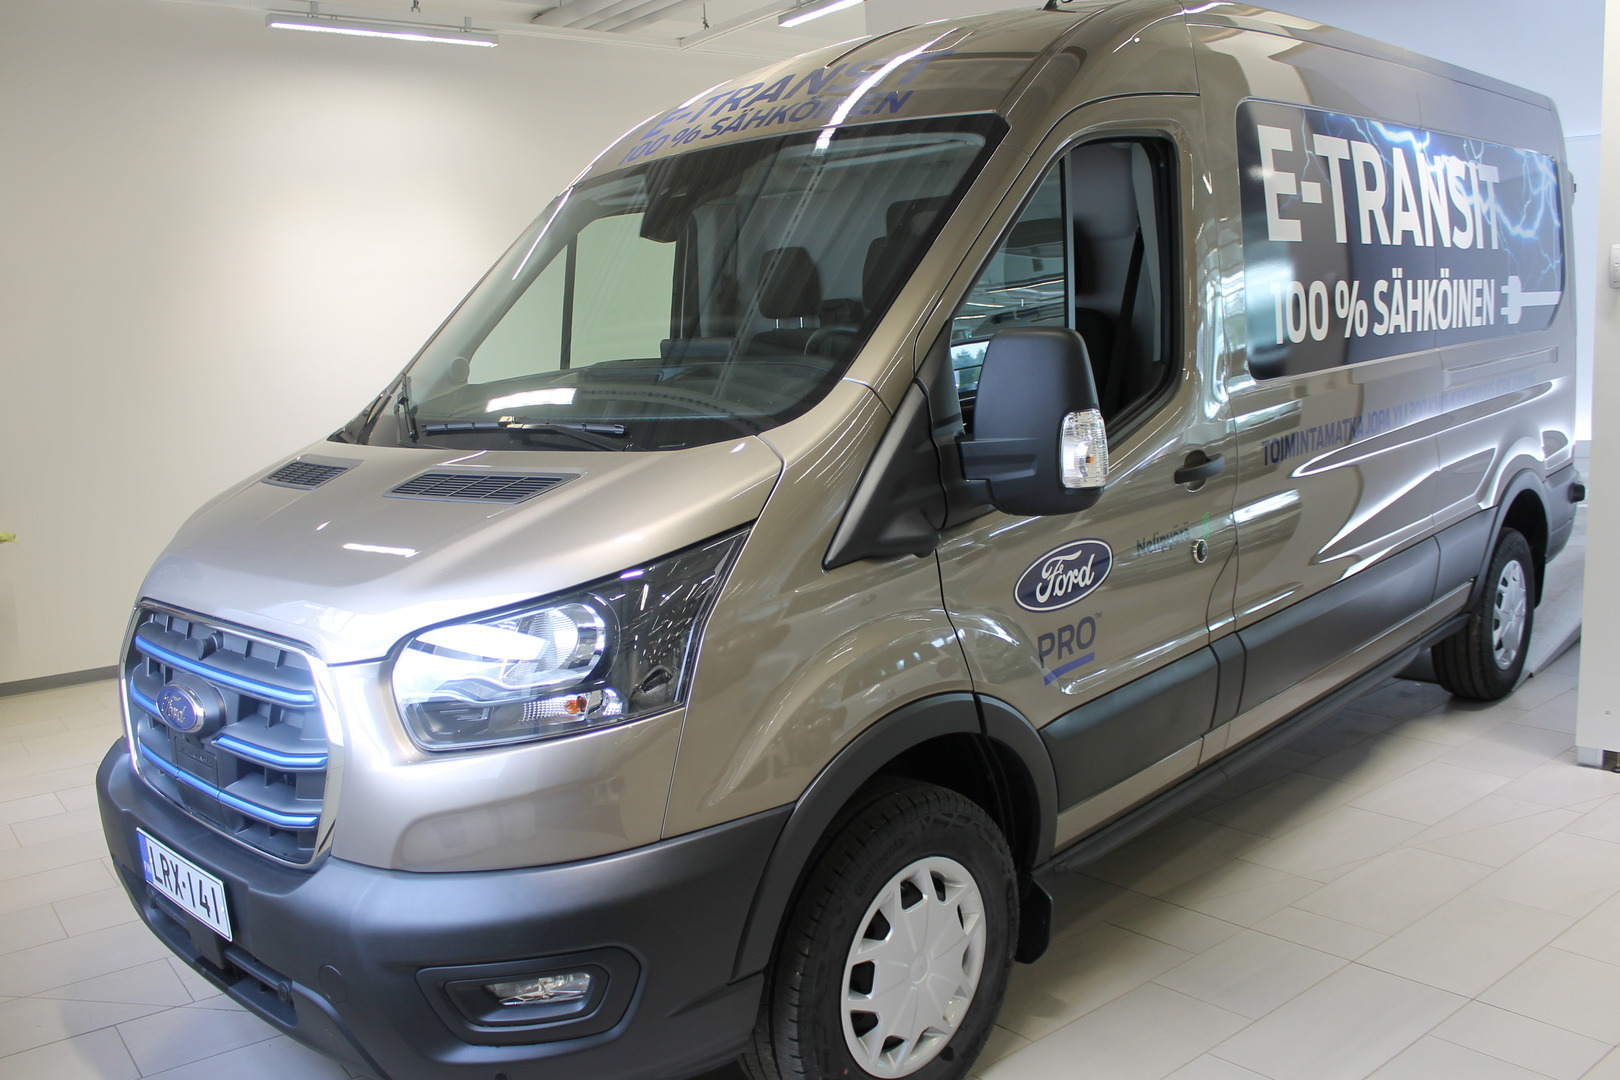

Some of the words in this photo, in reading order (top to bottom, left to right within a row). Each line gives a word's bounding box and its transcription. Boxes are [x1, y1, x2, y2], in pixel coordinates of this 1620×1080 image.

[640, 50, 953, 141] E-TRANST
[617, 134, 670, 166] 100
[671, 123, 703, 148] %
[1257, 124, 1500, 250] E-TRANSIT
[1271, 280, 1329, 345] 100
[1335, 280, 1368, 338] %
[1372, 267, 1495, 335] SÄHKÖINEN
[1261, 413, 1364, 466] TOIMINTAMATKA
[1036, 549, 1096, 603] Ford
[161, 692, 187, 724] Ford
[148, 844, 221, 925] LRX-141
